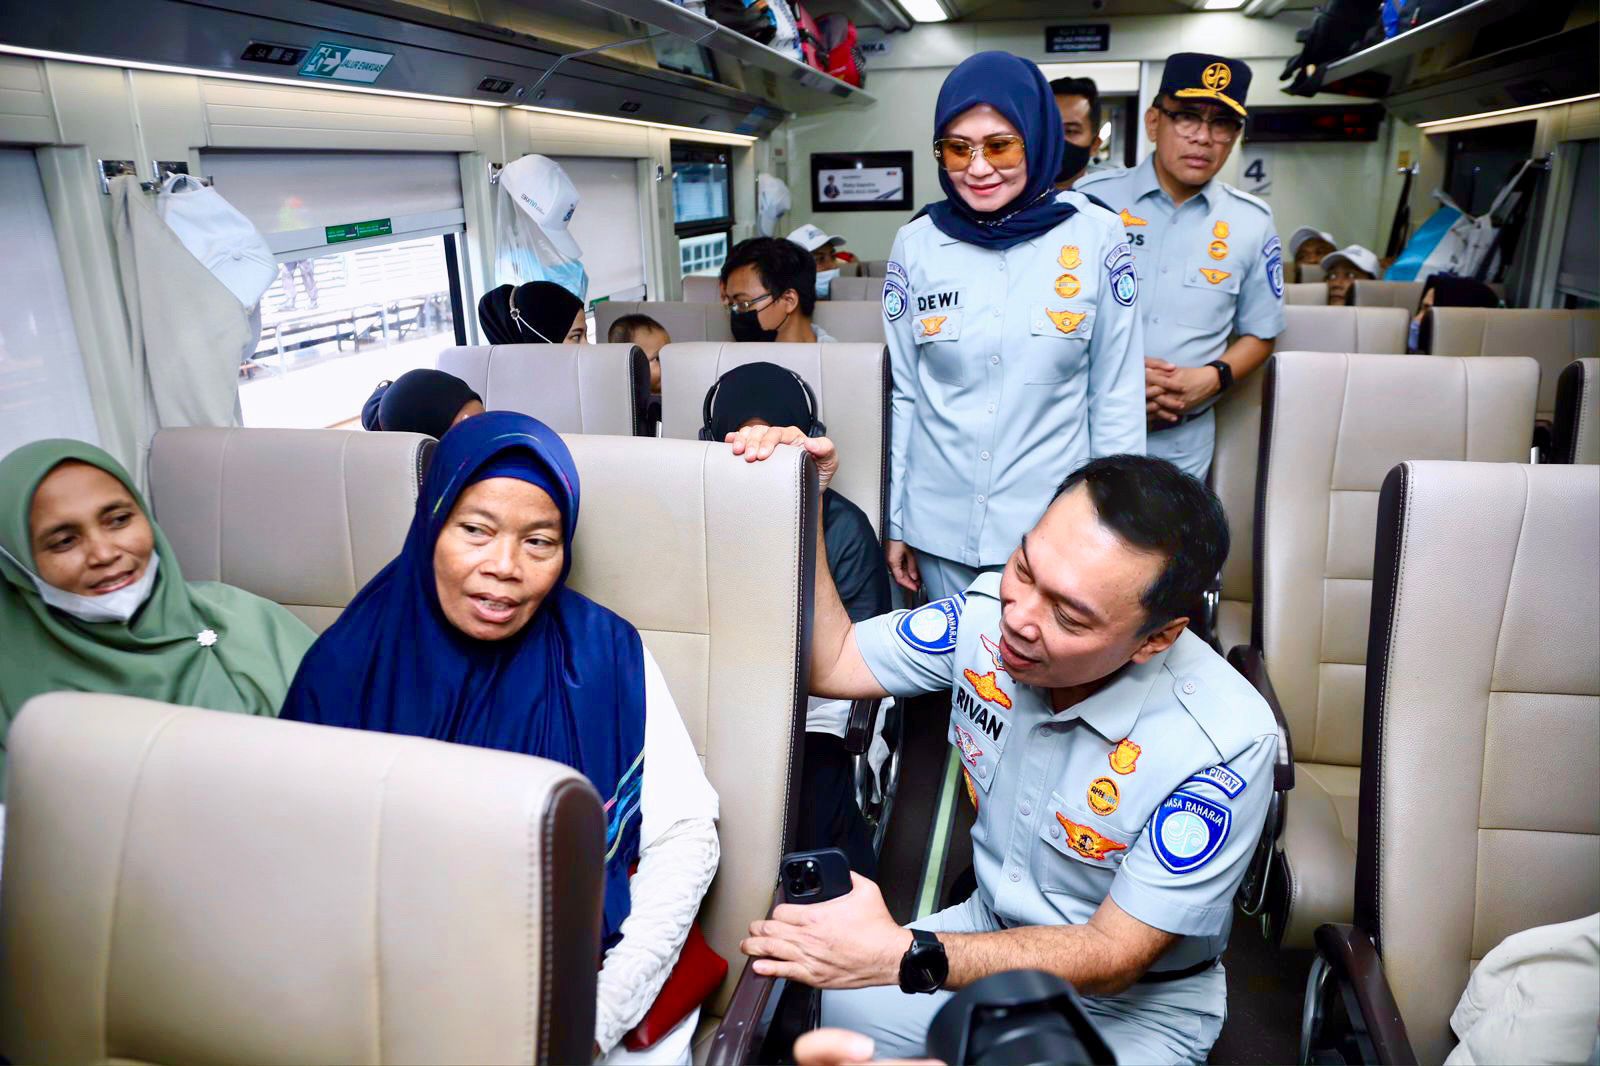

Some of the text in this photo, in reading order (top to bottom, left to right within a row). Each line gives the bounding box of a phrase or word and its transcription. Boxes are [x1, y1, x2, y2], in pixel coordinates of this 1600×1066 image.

[1244, 158, 1266, 182] 4
[917, 291, 959, 311] DEWI
[946, 613, 958, 644] RAHARJA
[957, 686, 1004, 741] RIVAN
[1209, 767, 1240, 791] PUSAT
[1164, 797, 1224, 827] JASA RAHARJA
